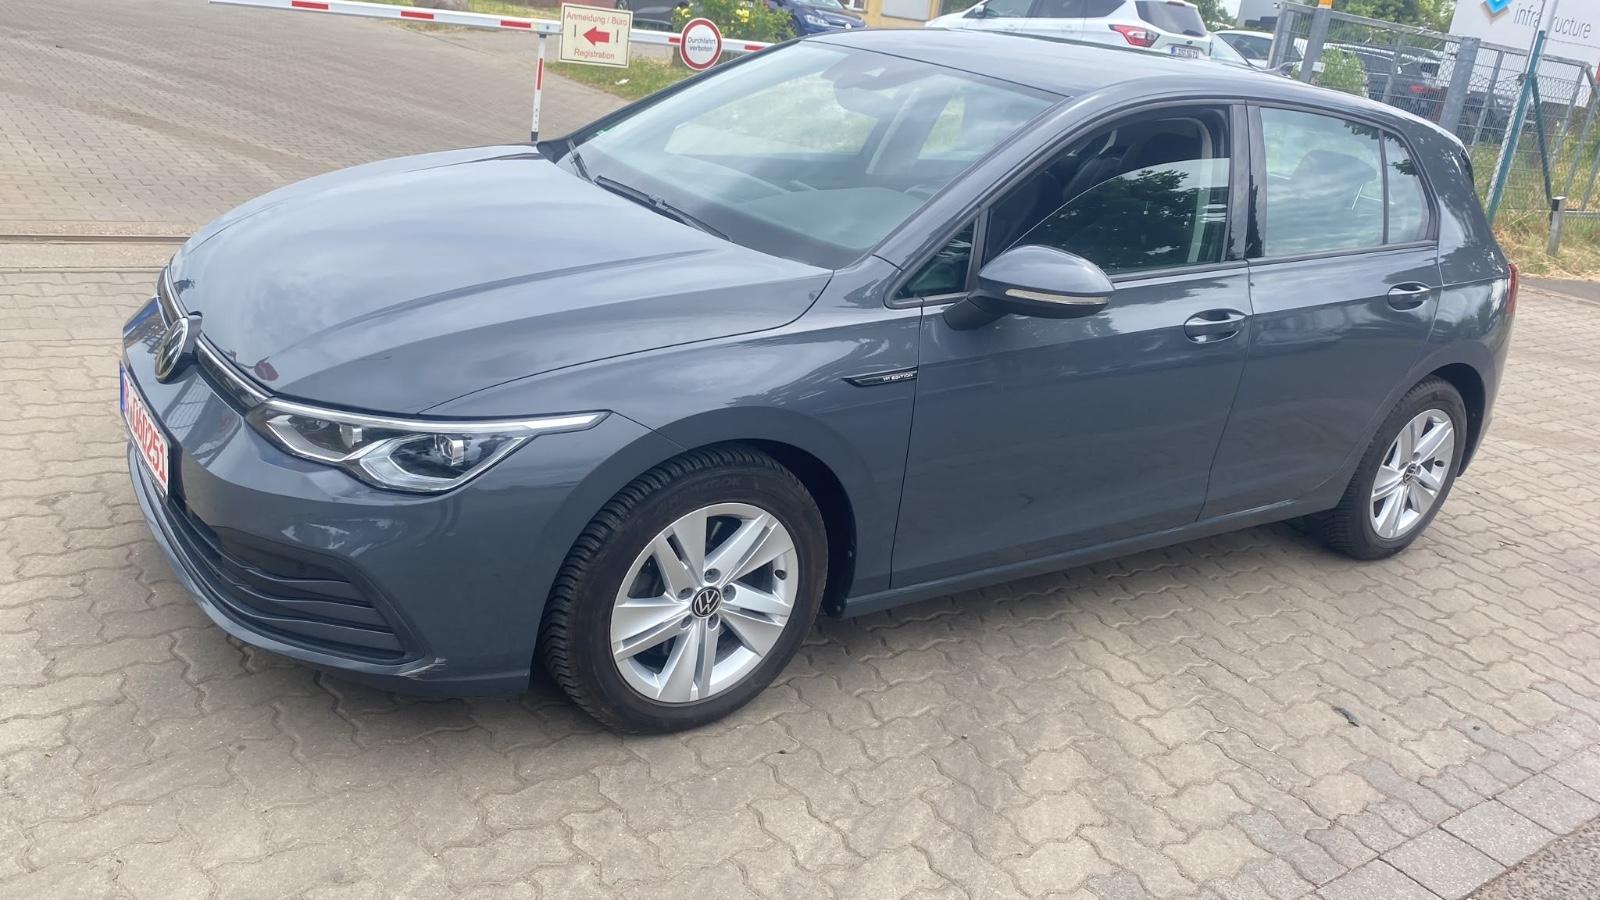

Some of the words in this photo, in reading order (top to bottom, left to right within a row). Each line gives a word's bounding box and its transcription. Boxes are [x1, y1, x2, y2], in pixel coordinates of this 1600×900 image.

[566, 12, 606, 25] Anmeldung
[611, 16, 628, 26] Büro
[1513, 3, 1591, 39] infraructure
[687, 36, 716, 44] Durchfahrt
[574, 48, 615, 60] Registration
